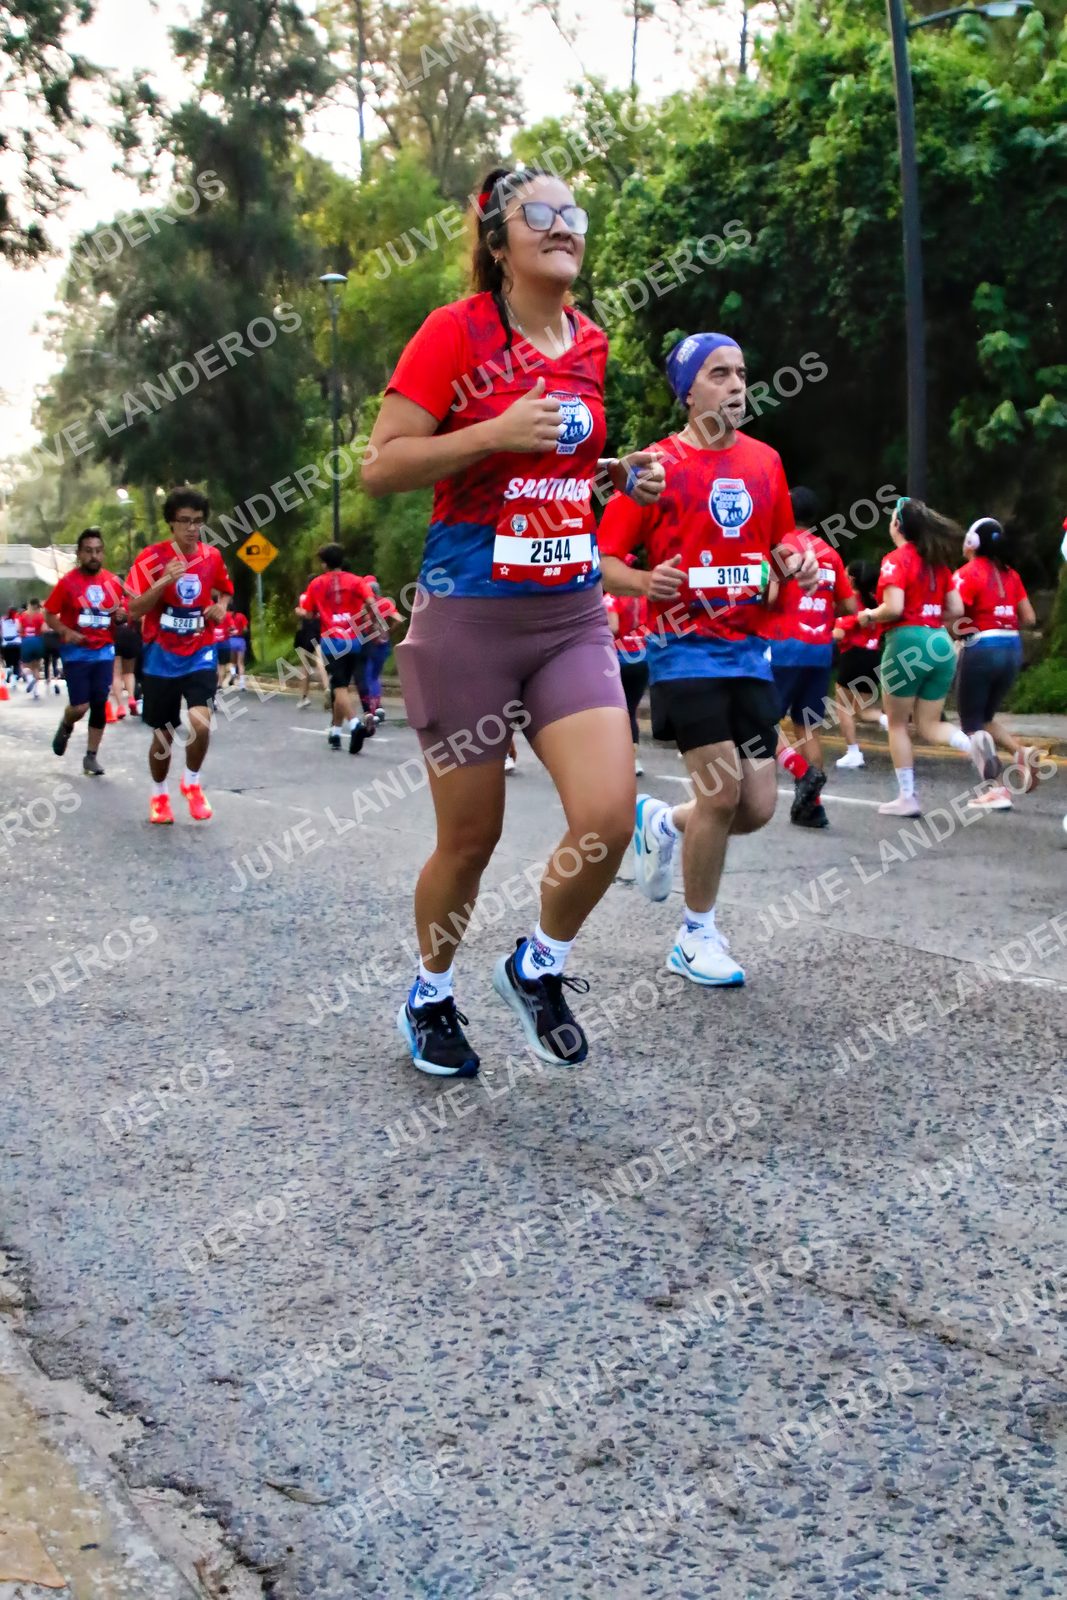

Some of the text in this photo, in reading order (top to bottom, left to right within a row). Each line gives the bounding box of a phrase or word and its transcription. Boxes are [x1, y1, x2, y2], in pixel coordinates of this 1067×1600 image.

[559, 405, 580, 415] lobal
[530, 539, 571, 563] 2544
[718, 568, 749, 585] 3104
